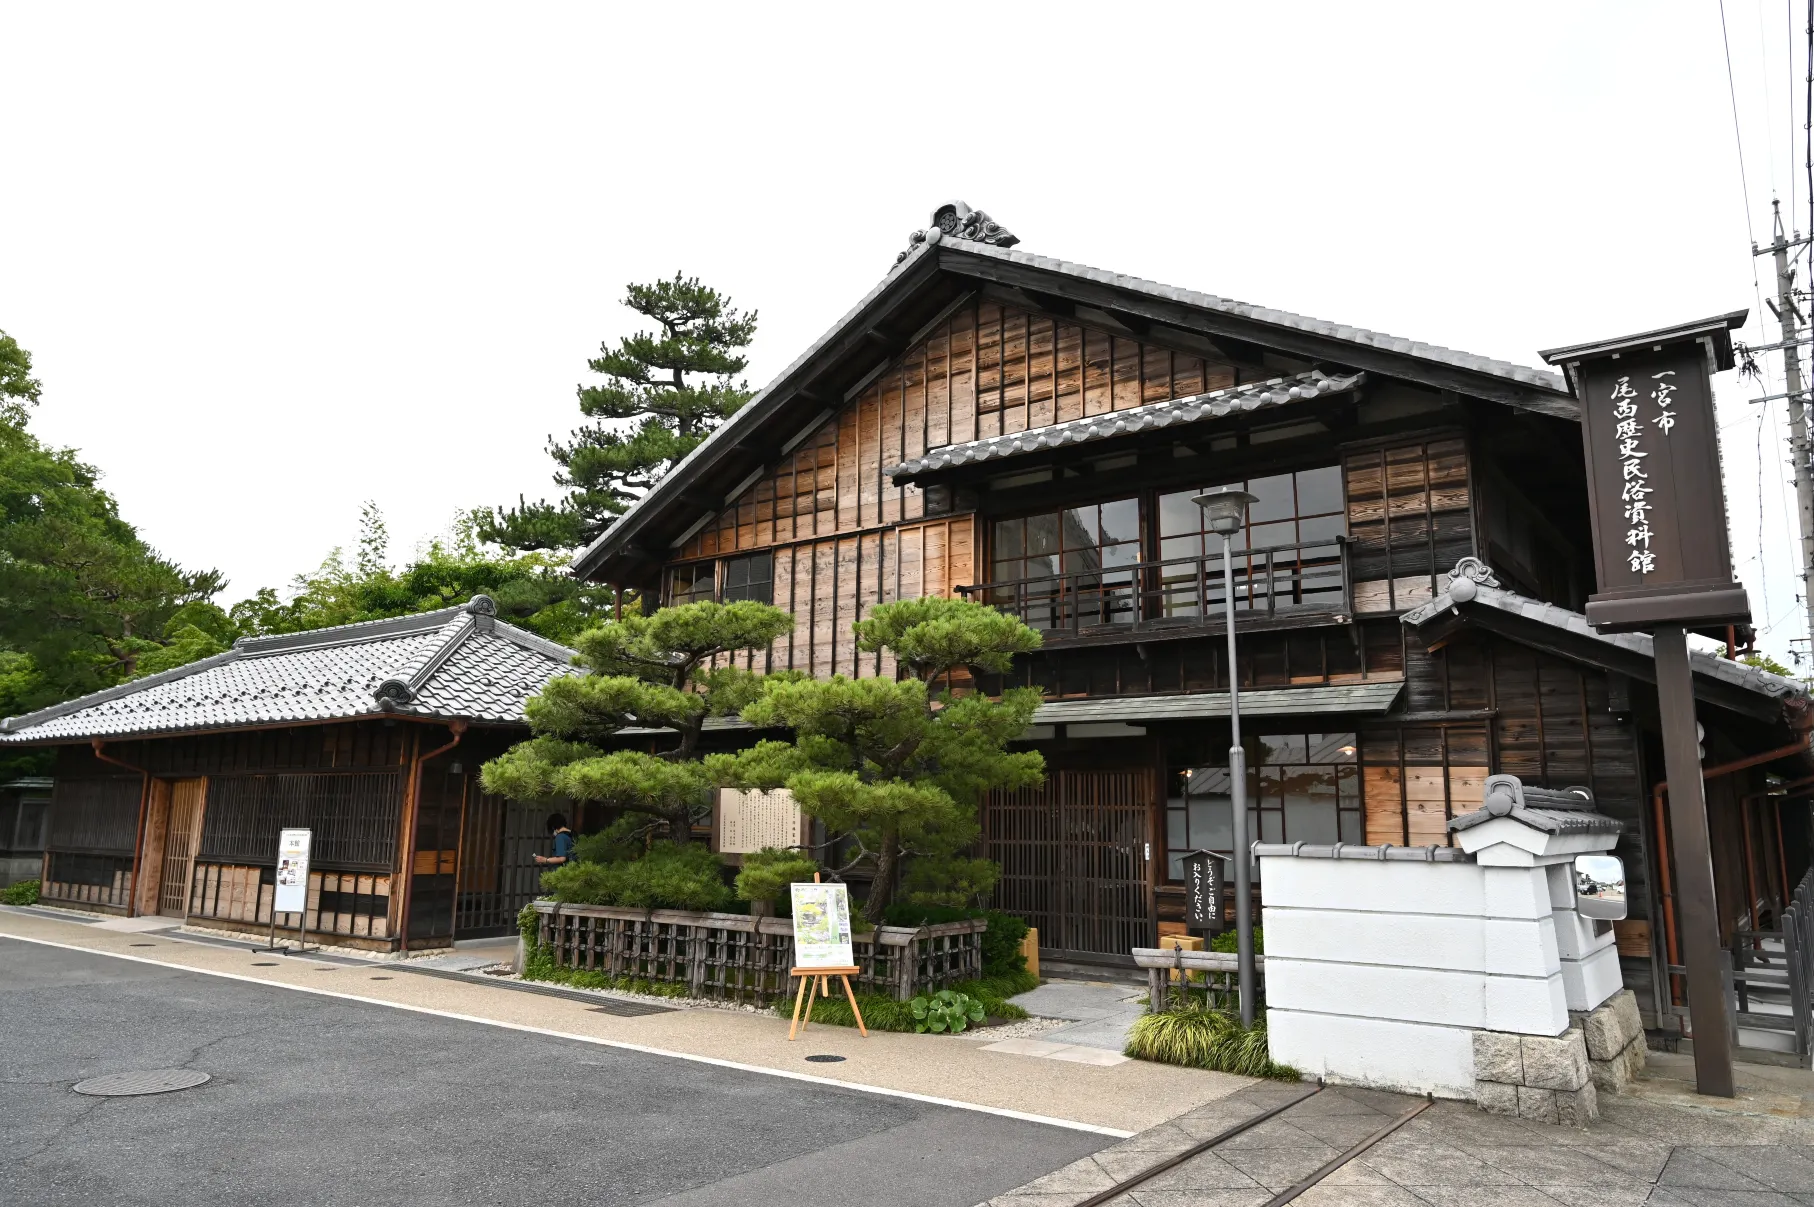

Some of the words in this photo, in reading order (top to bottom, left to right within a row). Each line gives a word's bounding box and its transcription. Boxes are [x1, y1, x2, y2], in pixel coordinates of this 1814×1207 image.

[1651, 370, 1678, 436] 一宮市
[1610, 376, 1657, 574] 尾西歴史民俗資料館
